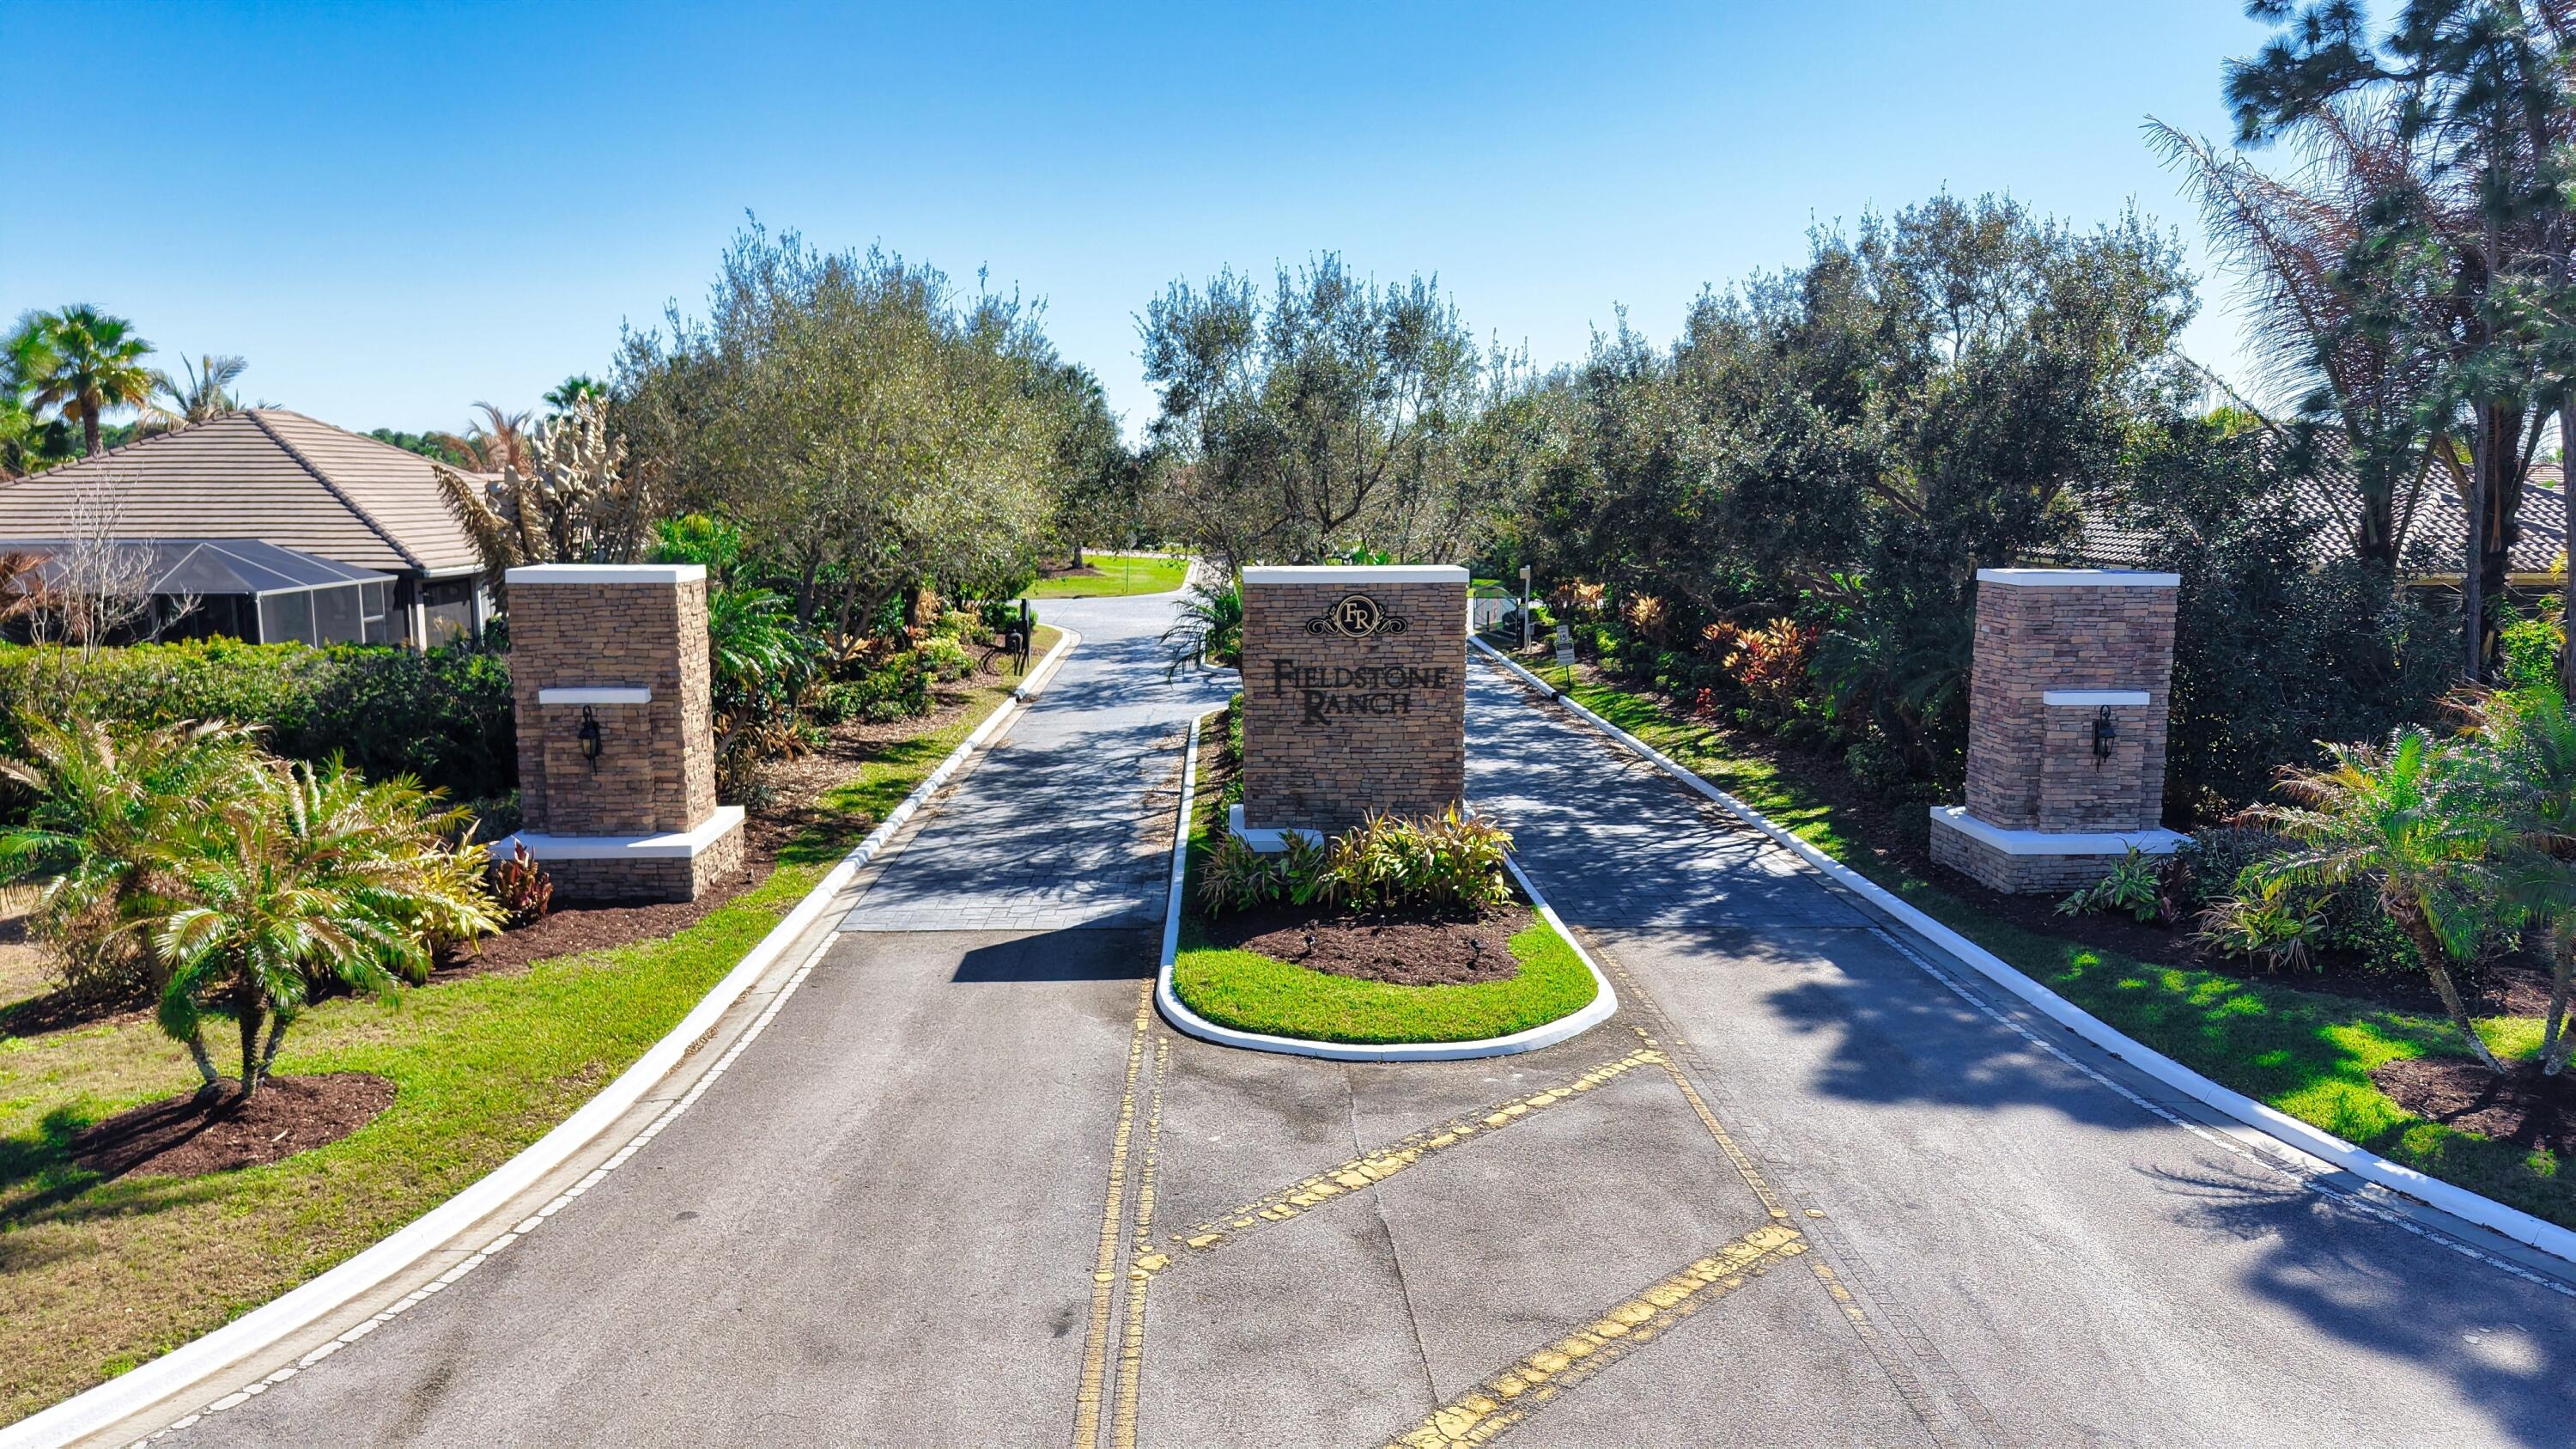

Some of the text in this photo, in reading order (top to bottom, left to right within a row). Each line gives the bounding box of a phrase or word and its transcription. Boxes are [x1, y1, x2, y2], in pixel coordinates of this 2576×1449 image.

[1344, 602, 1370, 630] FR
[1271, 659, 1447, 696] FIELDSTONE
[1300, 689, 1411, 726] RANCH
